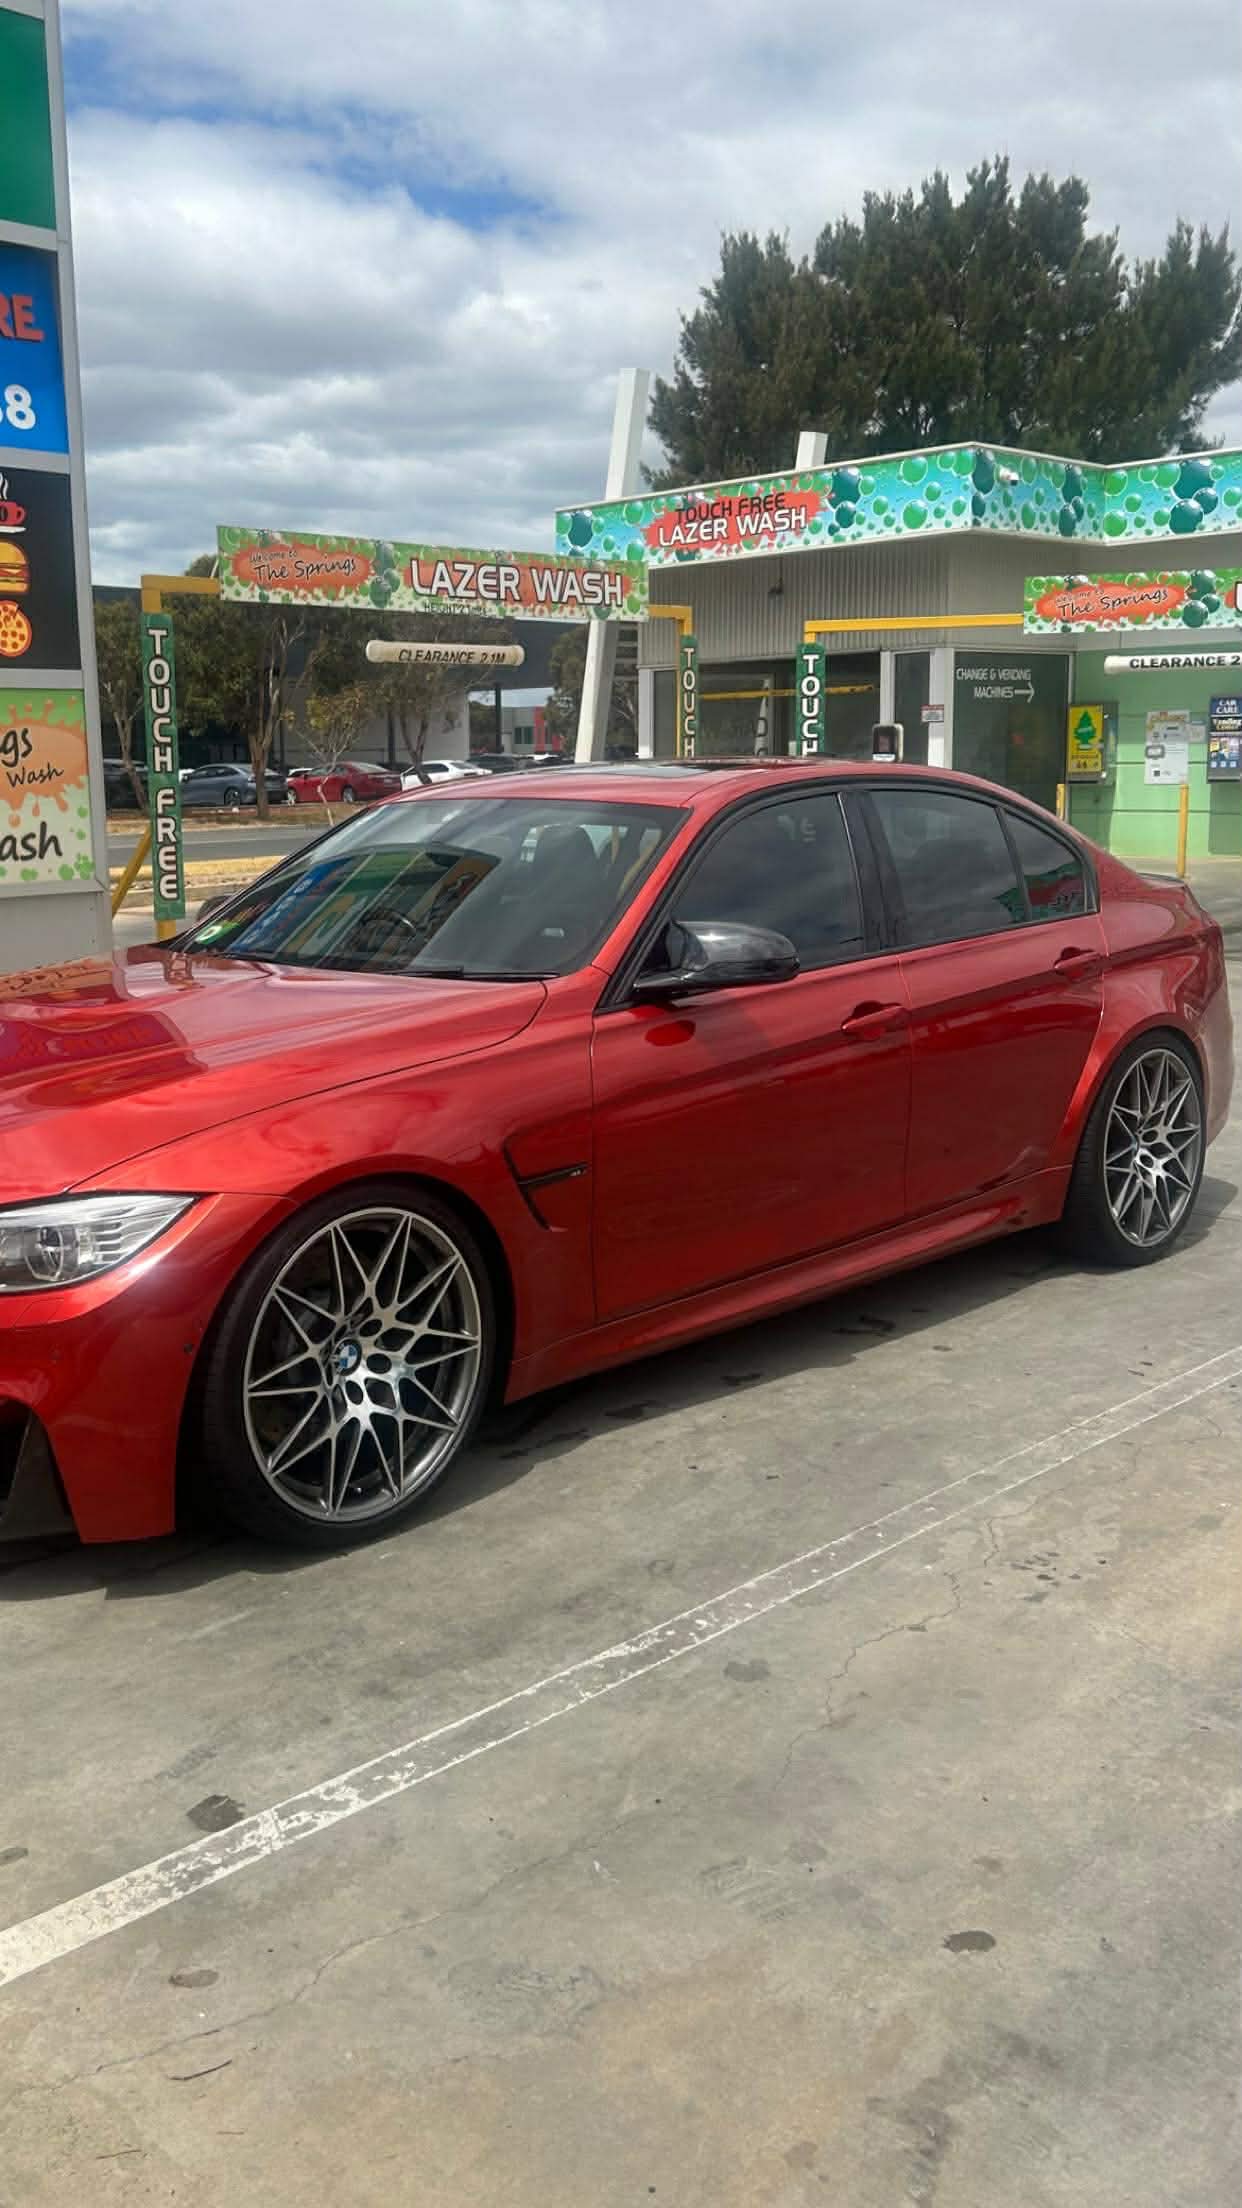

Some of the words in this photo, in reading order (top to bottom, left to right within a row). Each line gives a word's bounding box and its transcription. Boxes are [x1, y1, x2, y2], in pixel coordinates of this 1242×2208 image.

[675, 501, 732, 524] TOUCH
[738, 493, 785, 516] FREE
[658, 517, 728, 546] LAZER
[736, 506, 807, 536] WASH
[254, 564, 289, 580] The
[294, 554, 356, 580] Springs
[410, 559, 521, 601] LAZER
[530, 567, 623, 607] WASH
[1058, 602, 1094, 617] The
[1100, 588, 1168, 610] Springs
[398, 649, 475, 664] CLEARANCE
[1129, 655, 1225, 669] CLEARANCE
[956, 668, 989, 681] CHANGE
[997, 668, 1032, 681] VENDING
[149, 628, 173, 773] TOUCH
[683, 647, 696, 758] TOUCH
[973, 686, 1014, 698] MACHINES
[0, 727, 33, 768] gs
[7, 762, 65, 788] Wash
[0, 821, 63, 862] ash
[156, 788, 179, 900] FREE
